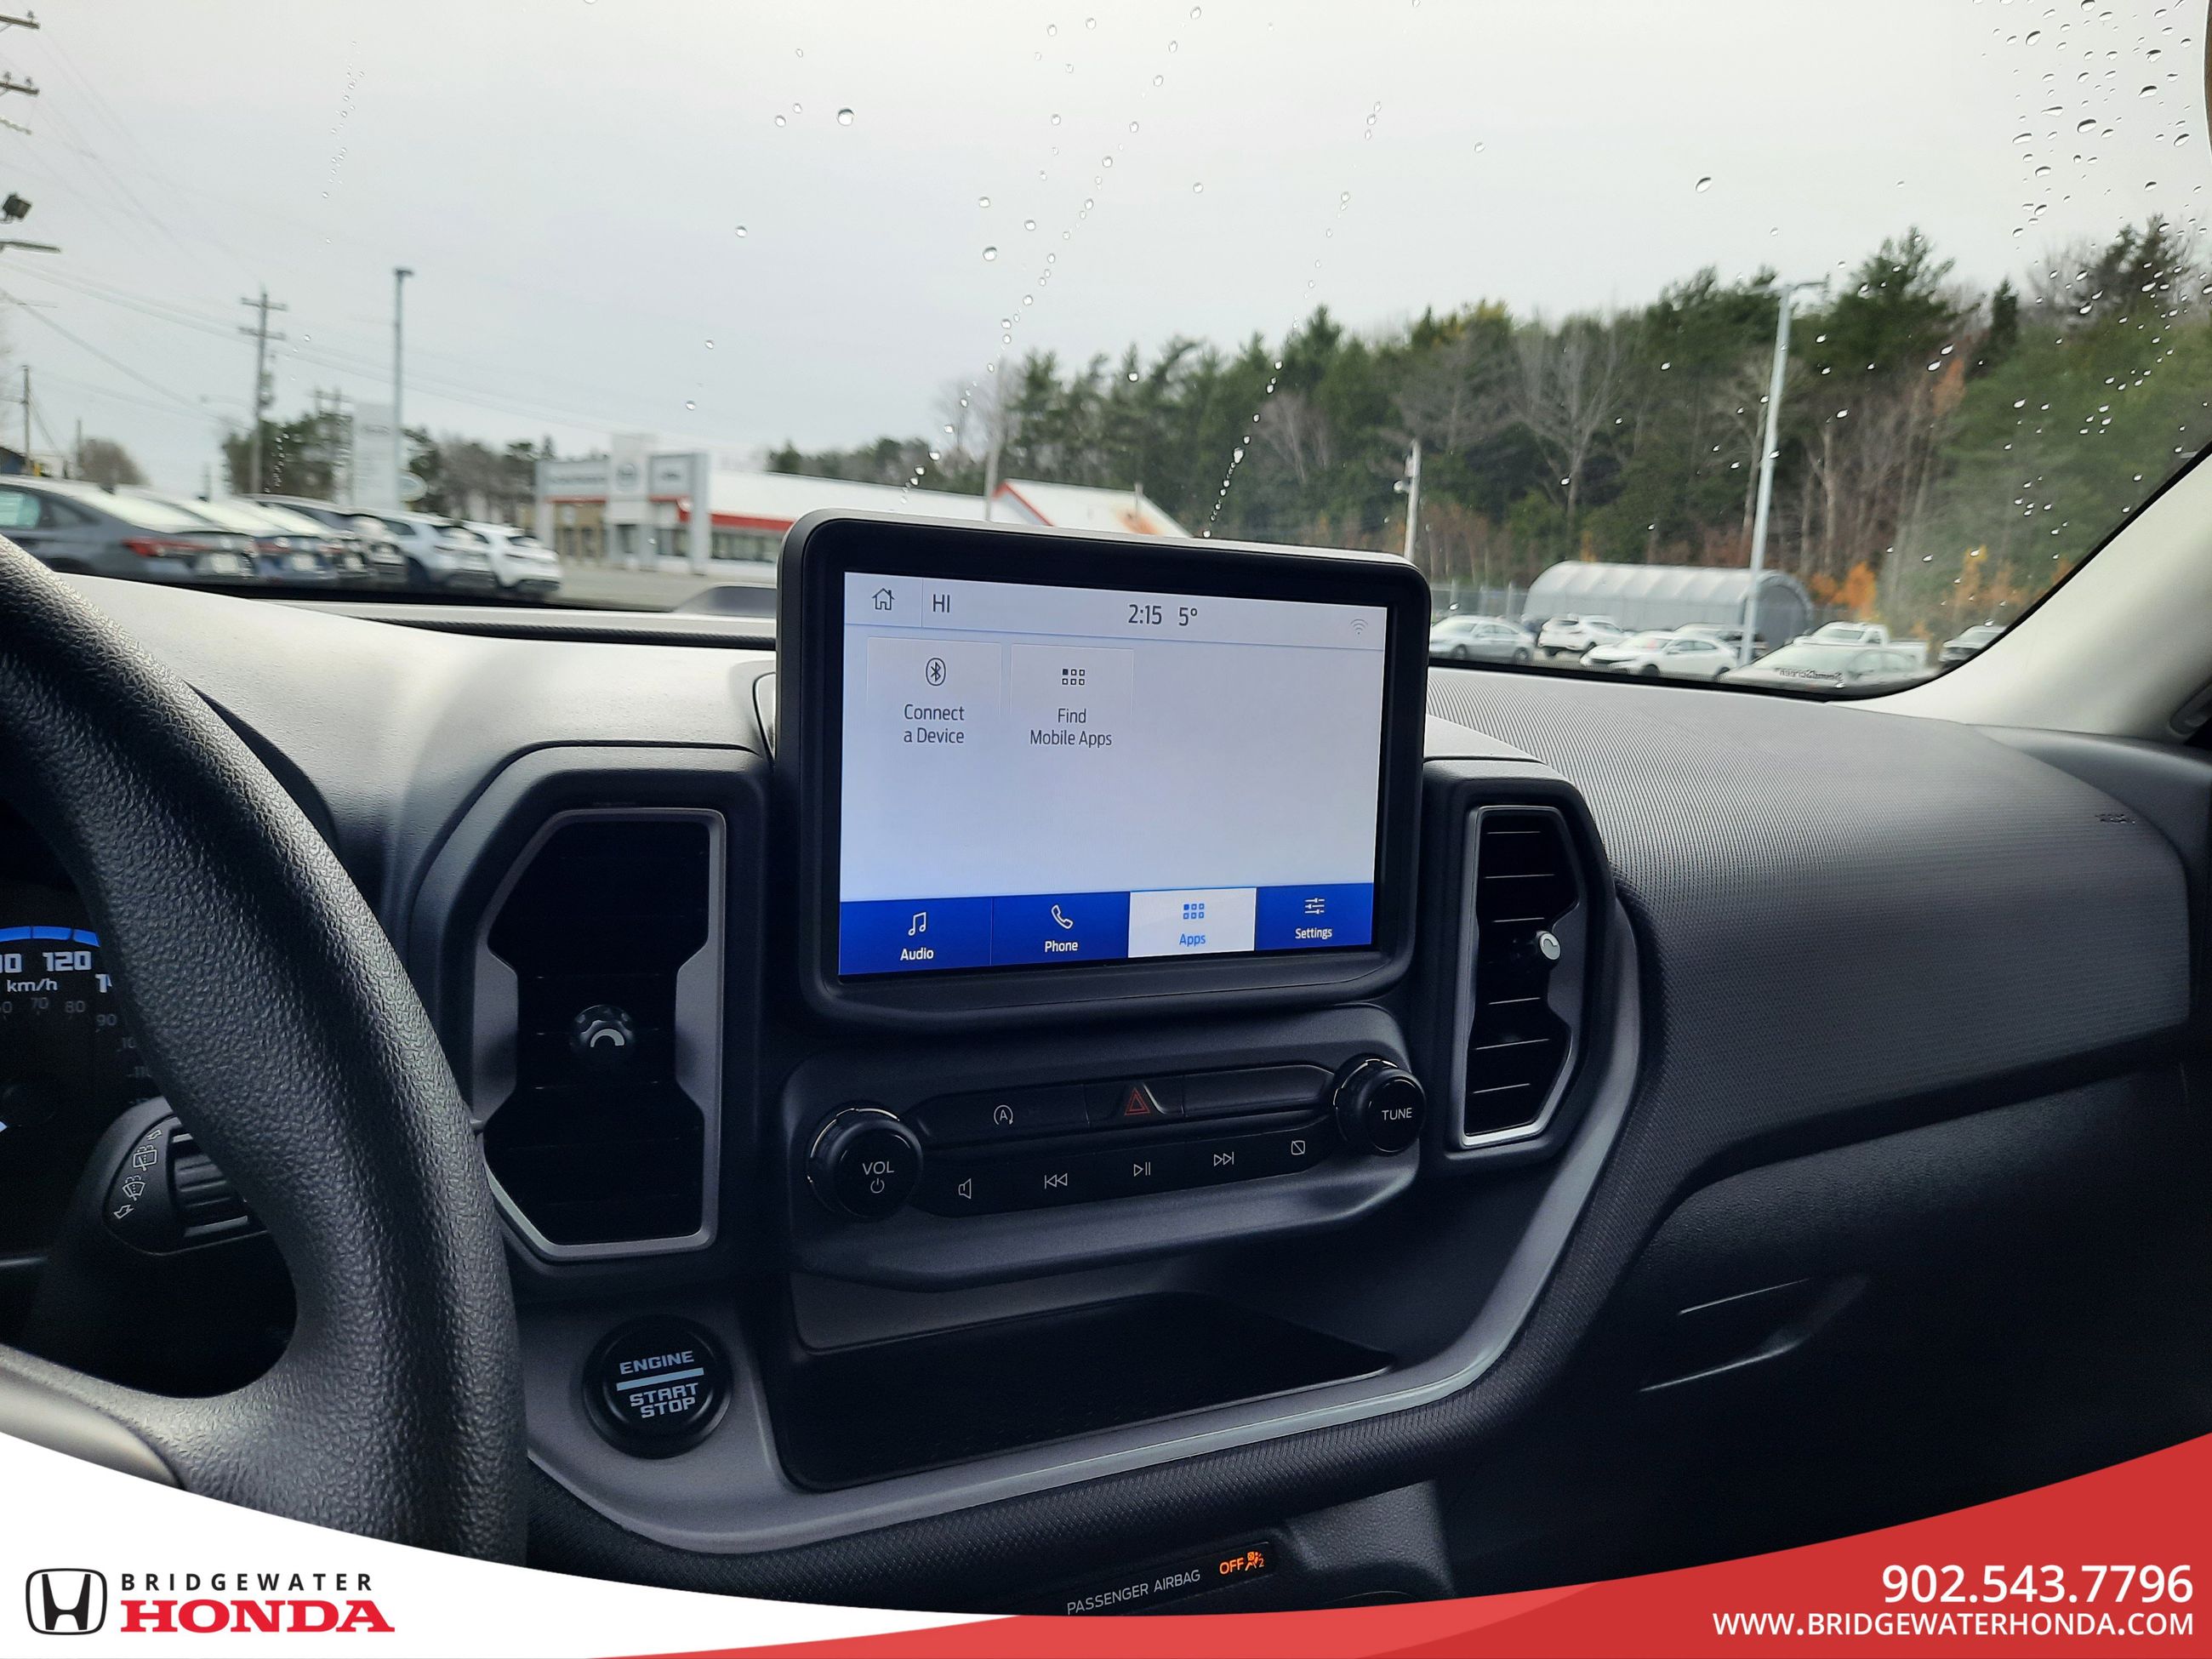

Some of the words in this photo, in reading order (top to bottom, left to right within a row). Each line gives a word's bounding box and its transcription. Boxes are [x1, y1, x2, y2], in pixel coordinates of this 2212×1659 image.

[932, 594, 950, 613] HI
[1128, 604, 1163, 625] 2:15
[904, 704, 965, 721] Connect
[1058, 708, 1086, 724] Find
[904, 731, 913, 743] a
[916, 727, 965, 744] Device
[1030, 729, 1075, 745] Mobile
[1078, 730, 1112, 749] Apps
[1178, 932, 1206, 948] Apps
[1295, 926, 1333, 942] Settings
[899, 947, 934, 961] Audio
[1044, 939, 1079, 954] Phone
[43, 950, 92, 972] 120
[6, 978, 59, 993] km/h
[1381, 1107, 1413, 1120] TUNE
[862, 1160, 895, 1176] VOL
[619, 1350, 695, 1375] ENGINE
[629, 1382, 698, 1407] START
[640, 1396, 696, 1418] STOP
[1218, 1557, 1245, 1575] OFF
[1067, 1582, 1149, 1616] PASSENGER
[1153, 1569, 1201, 1593] AIRBAG
